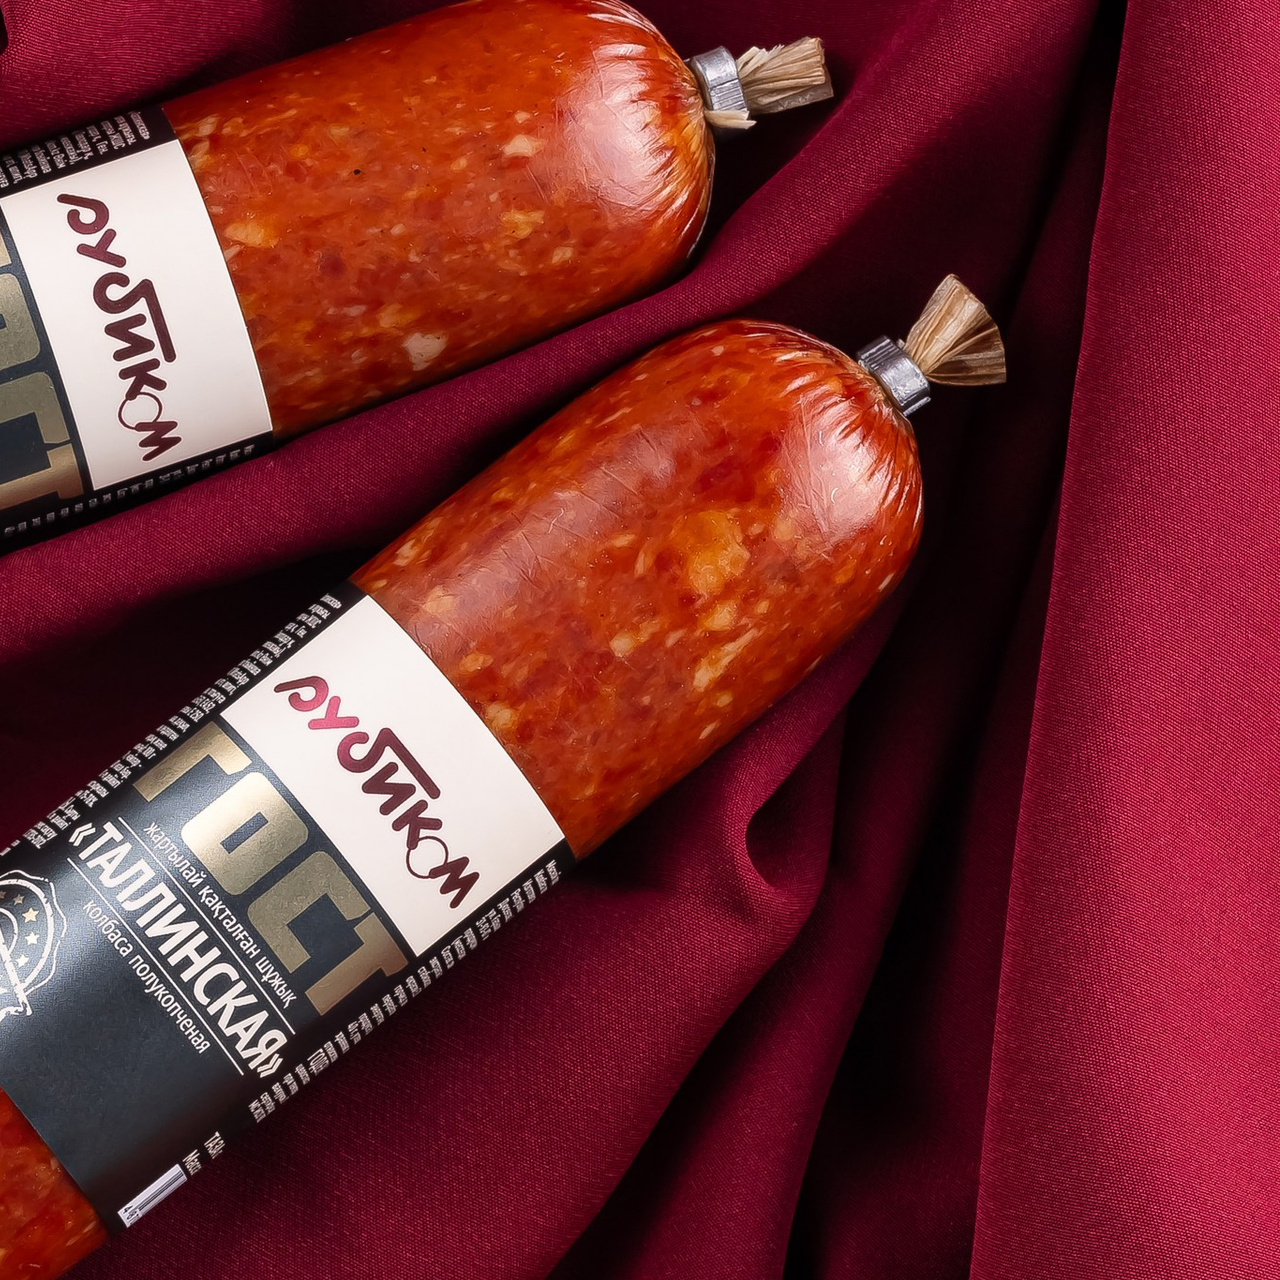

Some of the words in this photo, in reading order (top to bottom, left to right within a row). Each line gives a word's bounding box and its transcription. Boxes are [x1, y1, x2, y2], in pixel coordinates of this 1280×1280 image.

[68, 821, 288, 1078] «ТАЛЛИНСКАЯ»
[131, 720, 409, 1016] ГОСТ
[143, 822, 207, 889] жартылай
[82, 899, 134, 957] колбаса
[128, 954, 211, 1055] полукопченая
